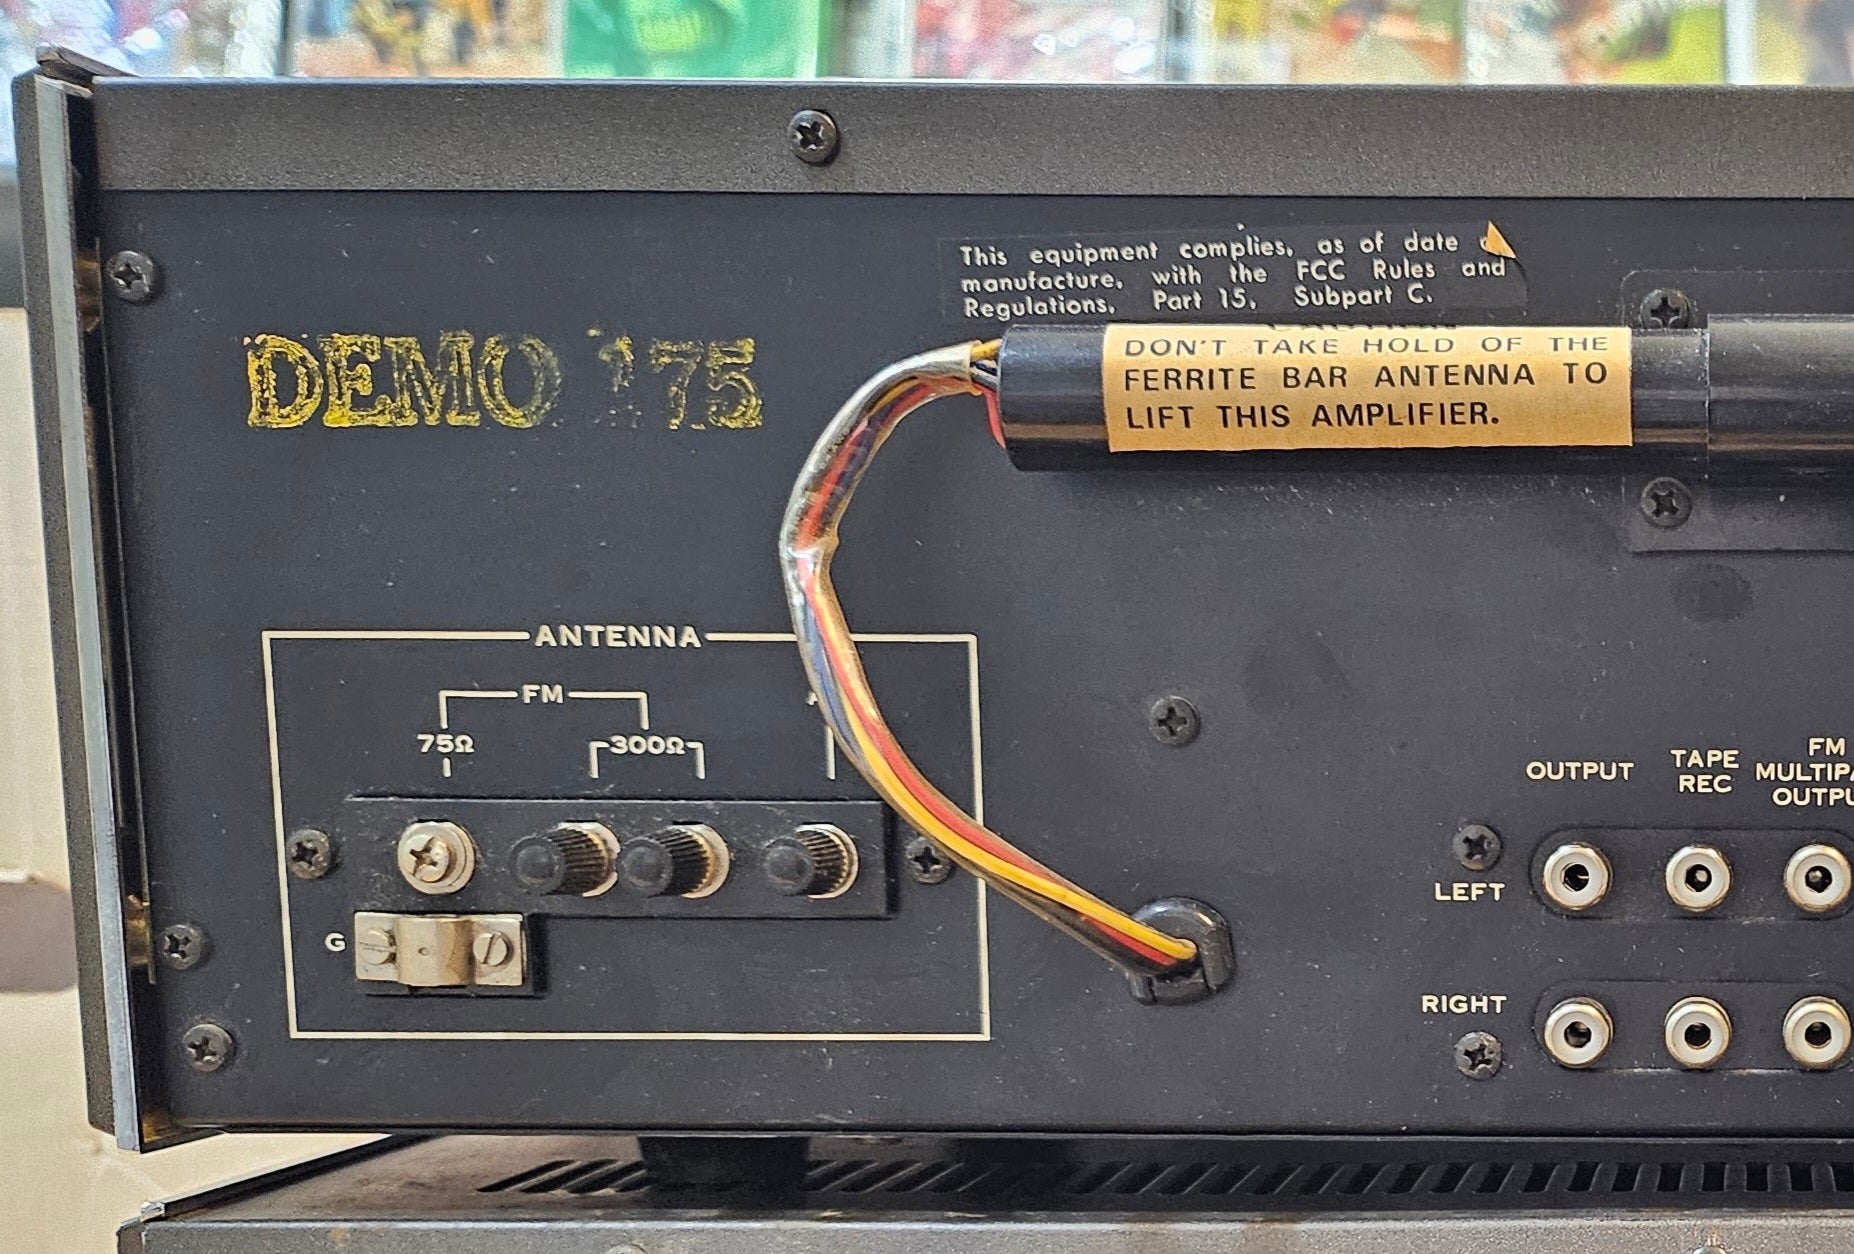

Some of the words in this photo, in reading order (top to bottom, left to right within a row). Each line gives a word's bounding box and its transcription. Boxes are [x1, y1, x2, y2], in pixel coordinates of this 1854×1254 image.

[959, 245, 1008, 267] This
[1029, 241, 1159, 268] equipment
[1179, 234, 1294, 262] complies,
[1317, 238, 1344, 255] as
[1359, 230, 1384, 254] of
[1404, 230, 1459, 252] date
[961, 270, 1123, 293] manufacture,
[1151, 263, 1202, 285] with
[1229, 261, 1267, 283] the
[1296, 258, 1346, 281] FCC
[1373, 256, 1436, 280] Rules
[1461, 257, 1506, 277] and
[1152, 289, 1202, 311] Part
[1294, 284, 1393, 310] Subpart
[1407, 282, 1433, 304] C.
[1125, 338, 1228, 357] DON'T
[1253, 338, 1338, 355] TAKE
[1363, 337, 1454, 354] HOLD
[1480, 336, 1522, 353] OF
[1548, 336, 1608, 352] THE
[242, 329, 562, 429] DEMO
[1125, 367, 1257, 392] FERRITE
[1283, 365, 1347, 389] BAR
[1374, 363, 1535, 388] ANTENNA
[1562, 361, 1607, 385] TO
[1126, 405, 1195, 430] LIFT
[1215, 404, 1290, 429] THIS
[1311, 401, 1500, 428] AMPLIFIER.
[534, 624, 702, 648] ANTENNA
[521, 684, 564, 704] FM
[416, 733, 475, 754] 75Ω
[609, 735, 686, 755] 300Ω
[1809, 737, 1845, 757] FM
[1670, 749, 1740, 769] TAPE
[1526, 761, 1635, 781] OUTPUT
[1679, 774, 1732, 793] REC
[1434, 882, 1506, 901] LEFT
[324, 932, 346, 952] G
[1421, 994, 1507, 1014] RIGHT
